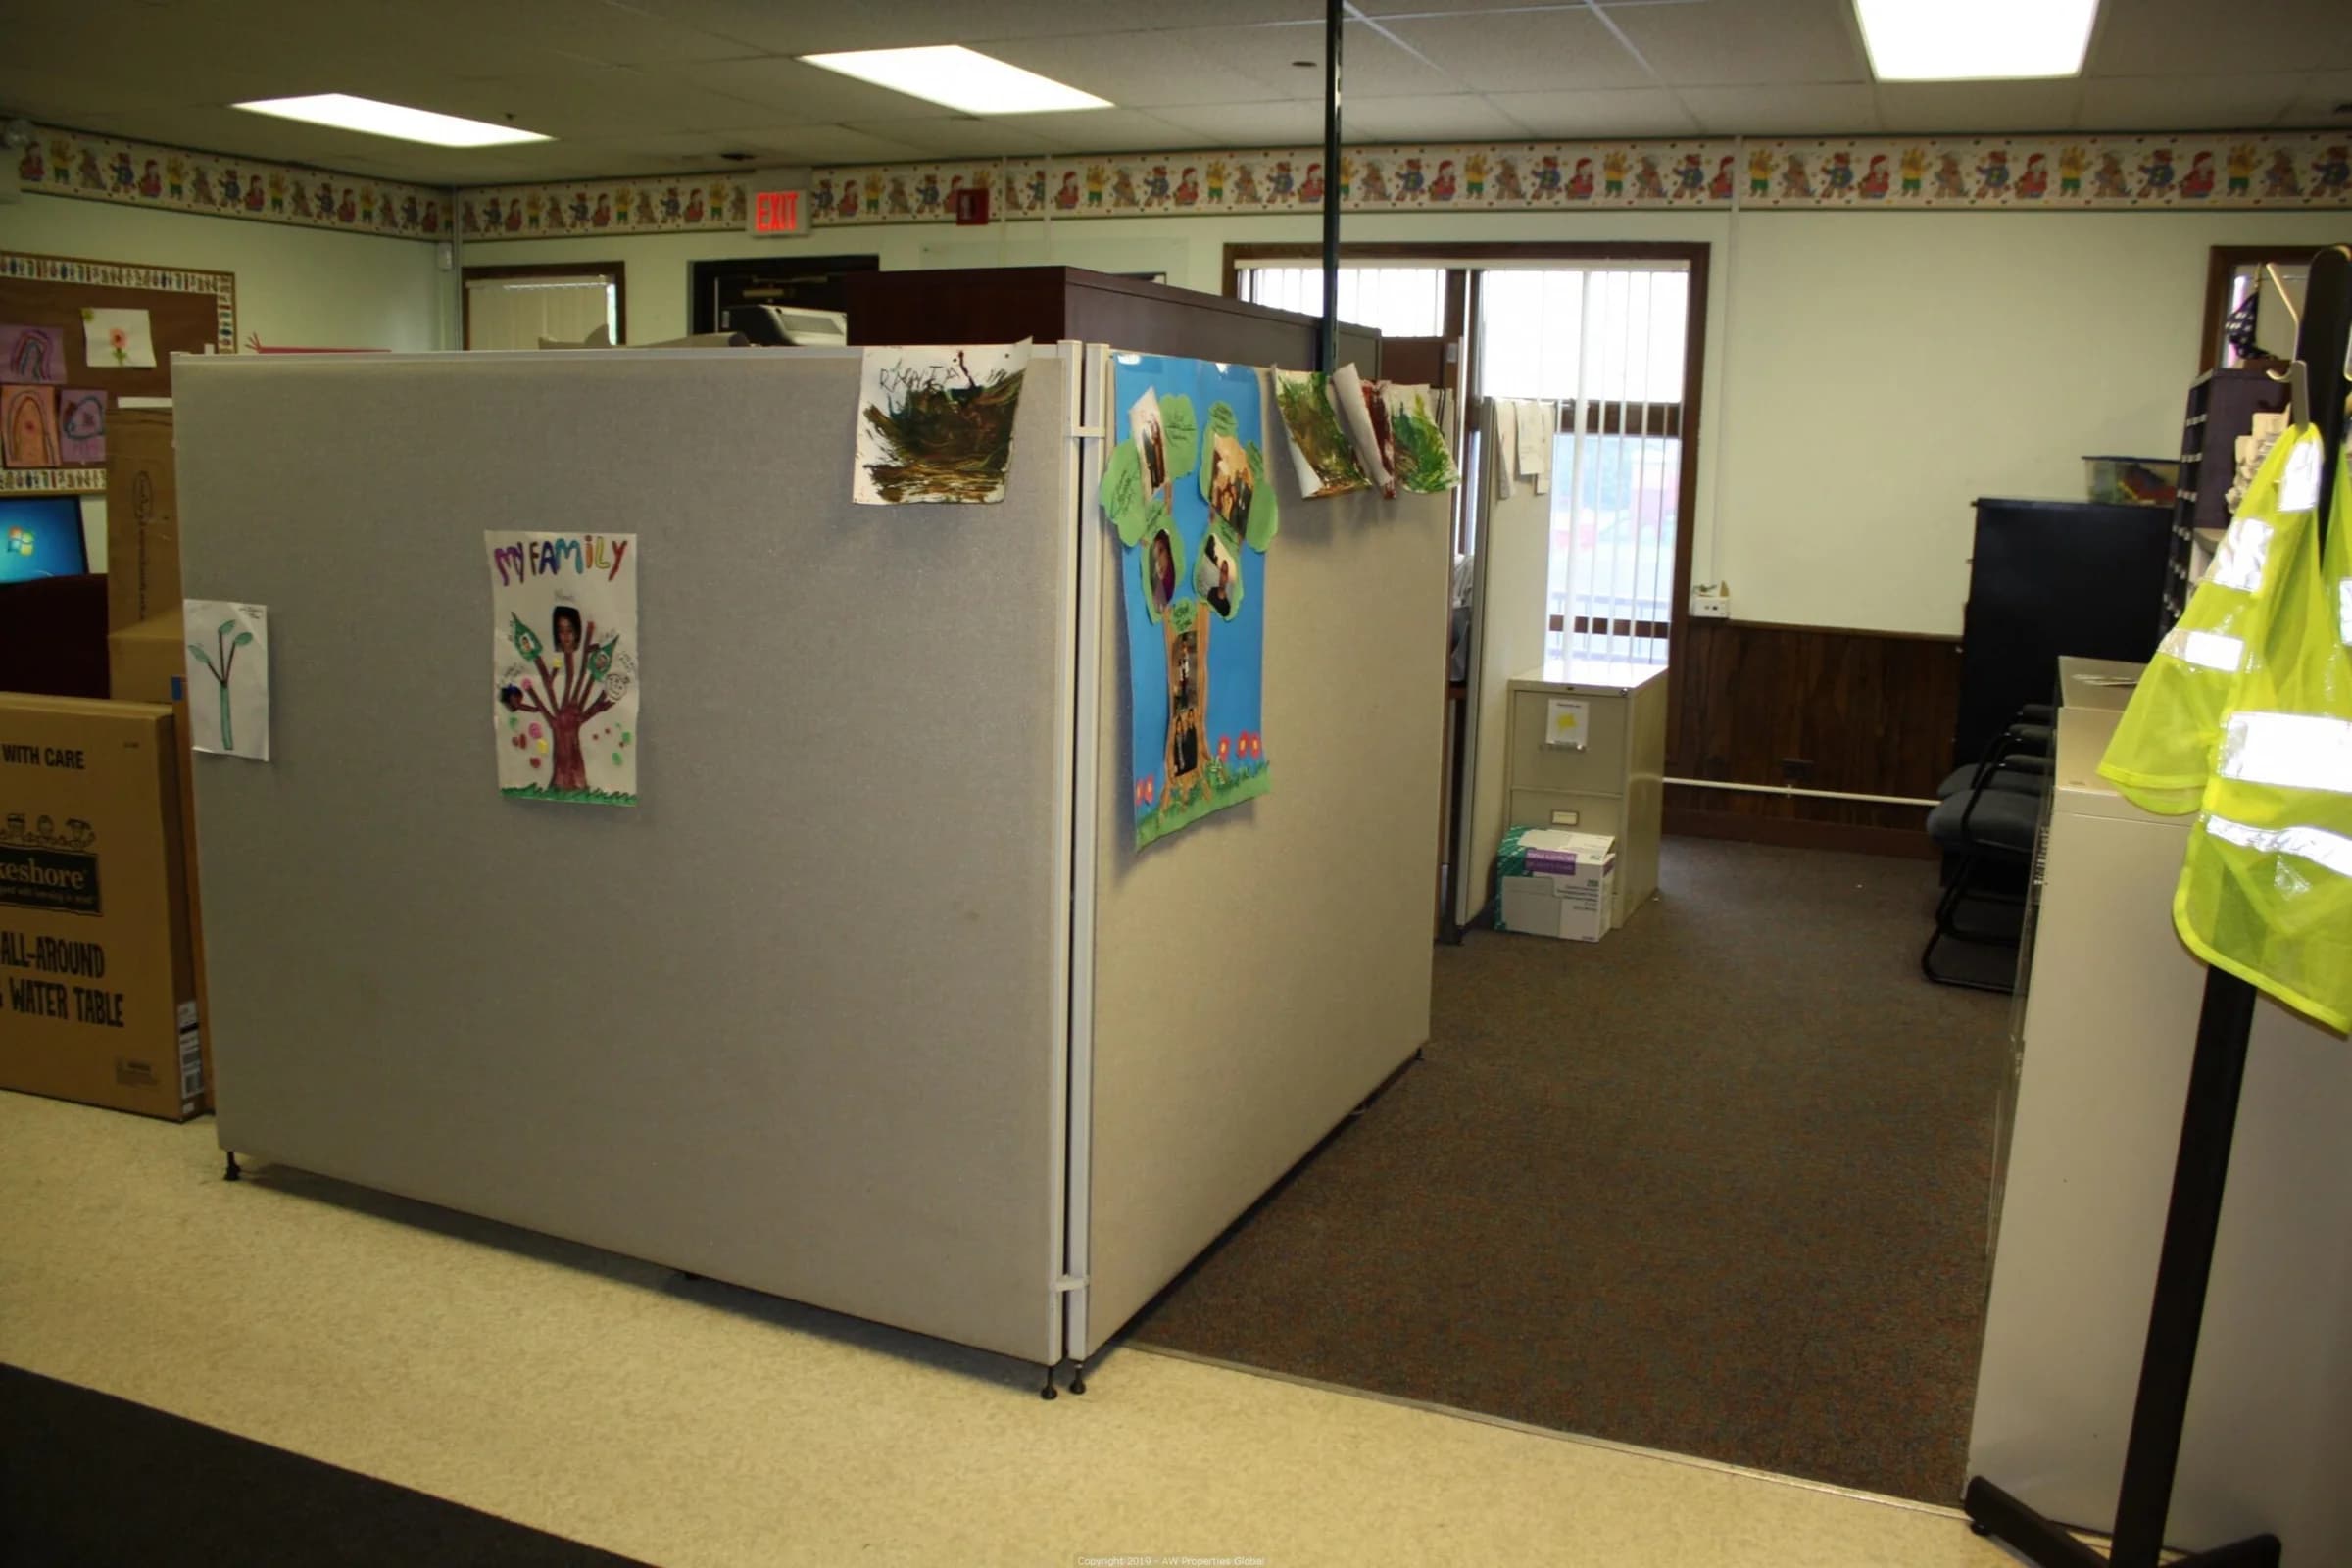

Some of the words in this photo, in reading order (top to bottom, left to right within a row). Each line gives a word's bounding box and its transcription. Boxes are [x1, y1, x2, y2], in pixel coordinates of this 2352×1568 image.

[757, 192, 798, 232] EXIT
[494, 541, 524, 586] MY
[2, 744, 40, 766] WITH
[44, 748, 85, 769] CARE
[1, 931, 105, 978] ALL-AROUND
[9, 977, 68, 1019] WATER
[74, 986, 124, 1027] TABLE
